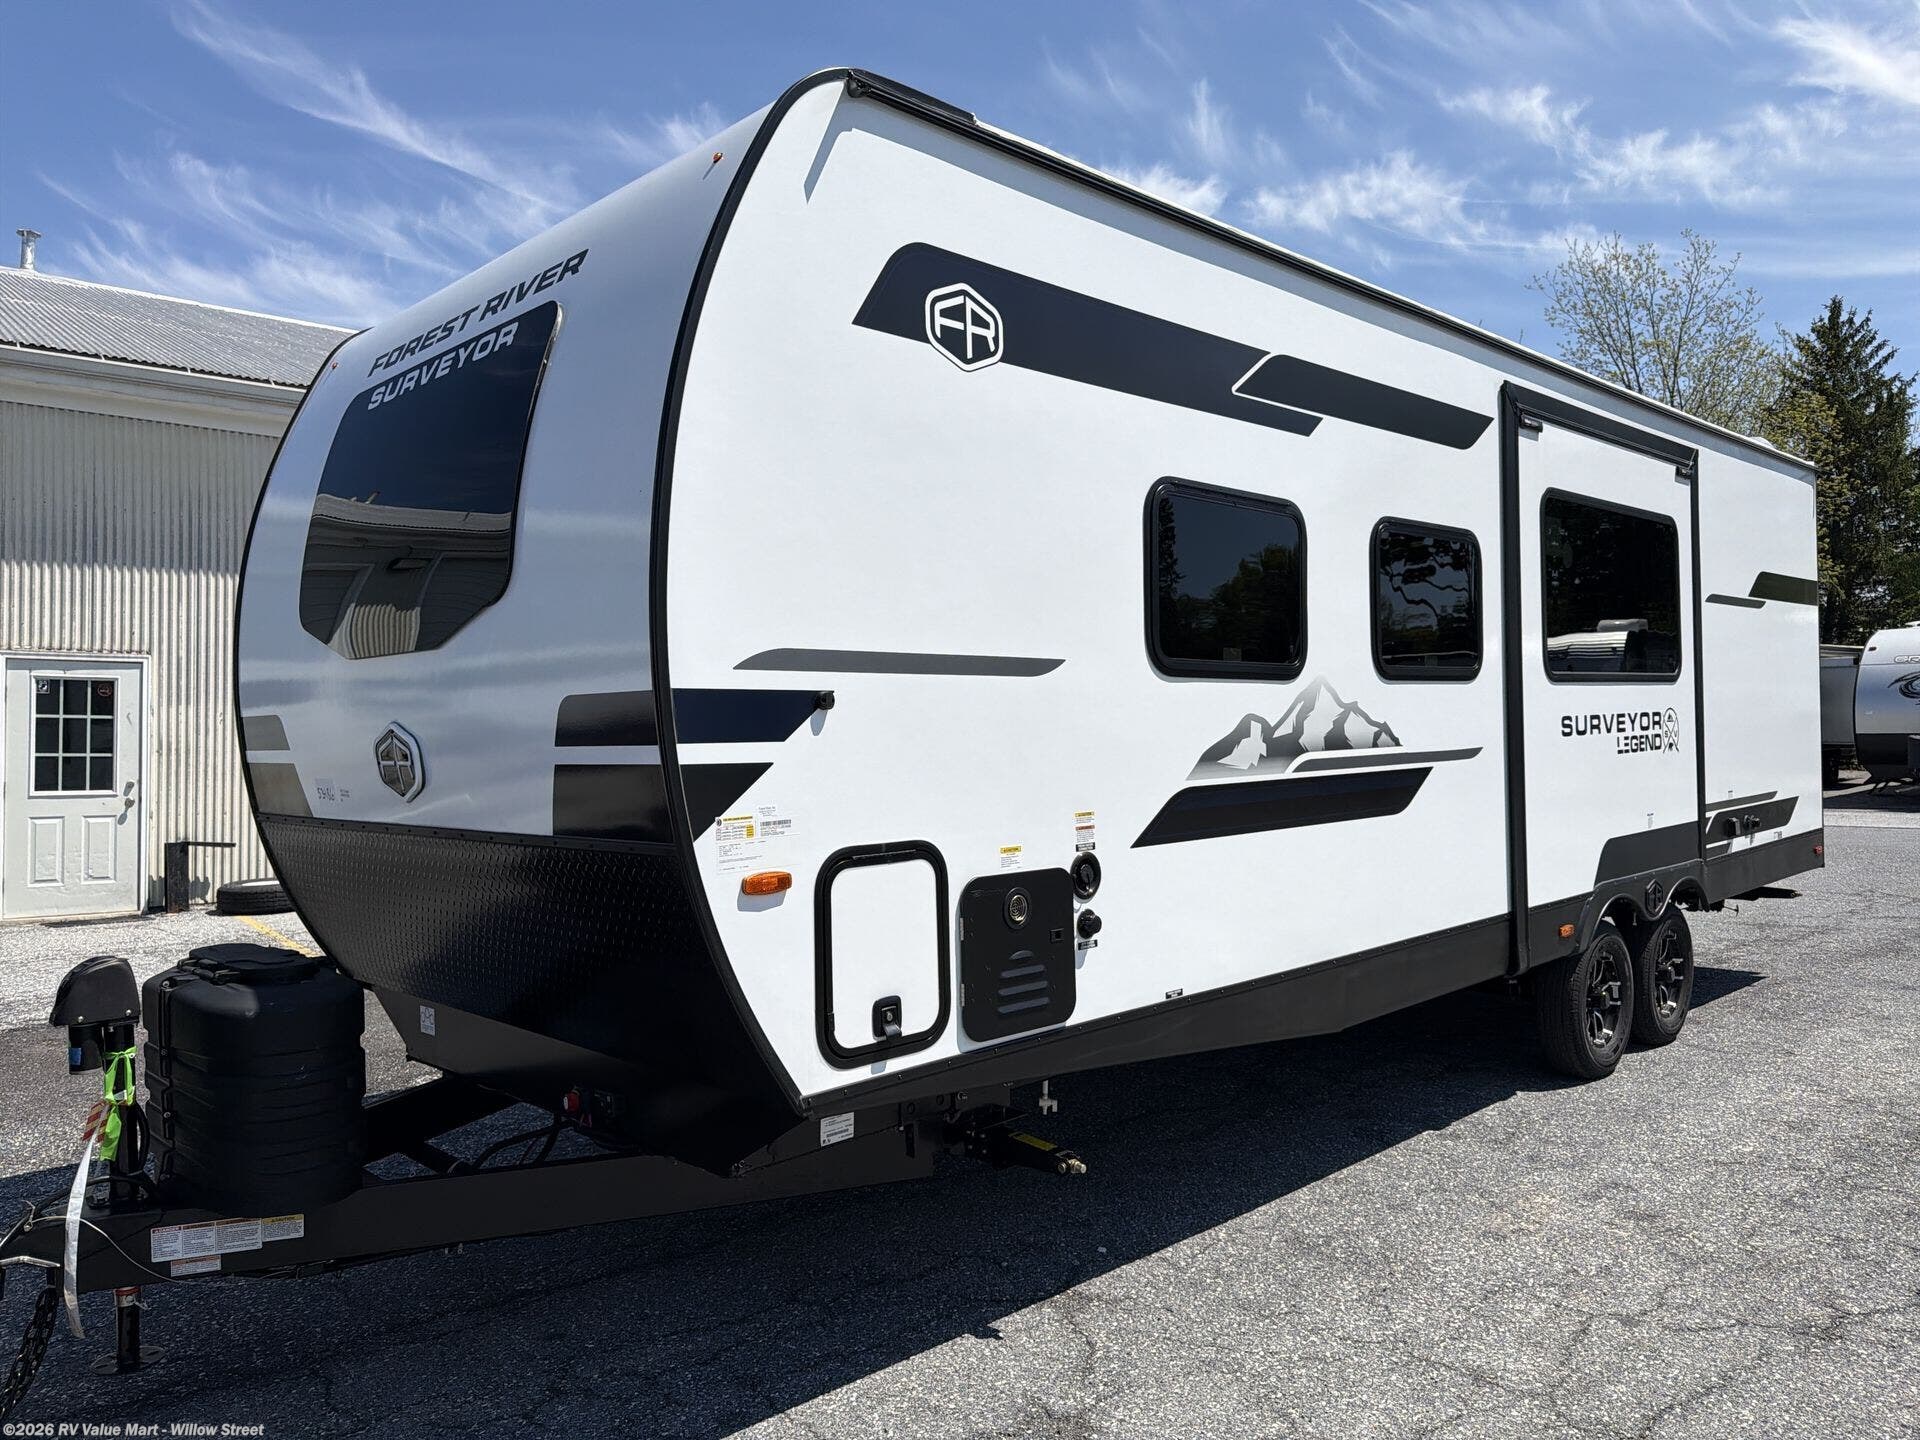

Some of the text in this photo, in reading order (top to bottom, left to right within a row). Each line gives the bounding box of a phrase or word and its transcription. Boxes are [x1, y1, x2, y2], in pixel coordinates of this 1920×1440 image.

[366, 248, 589, 378] FOREST RIVER
[367, 321, 521, 411] SURVEYOR
[1561, 711, 1662, 737] SURVEYOR
[1617, 733, 1662, 754] LEGEND
